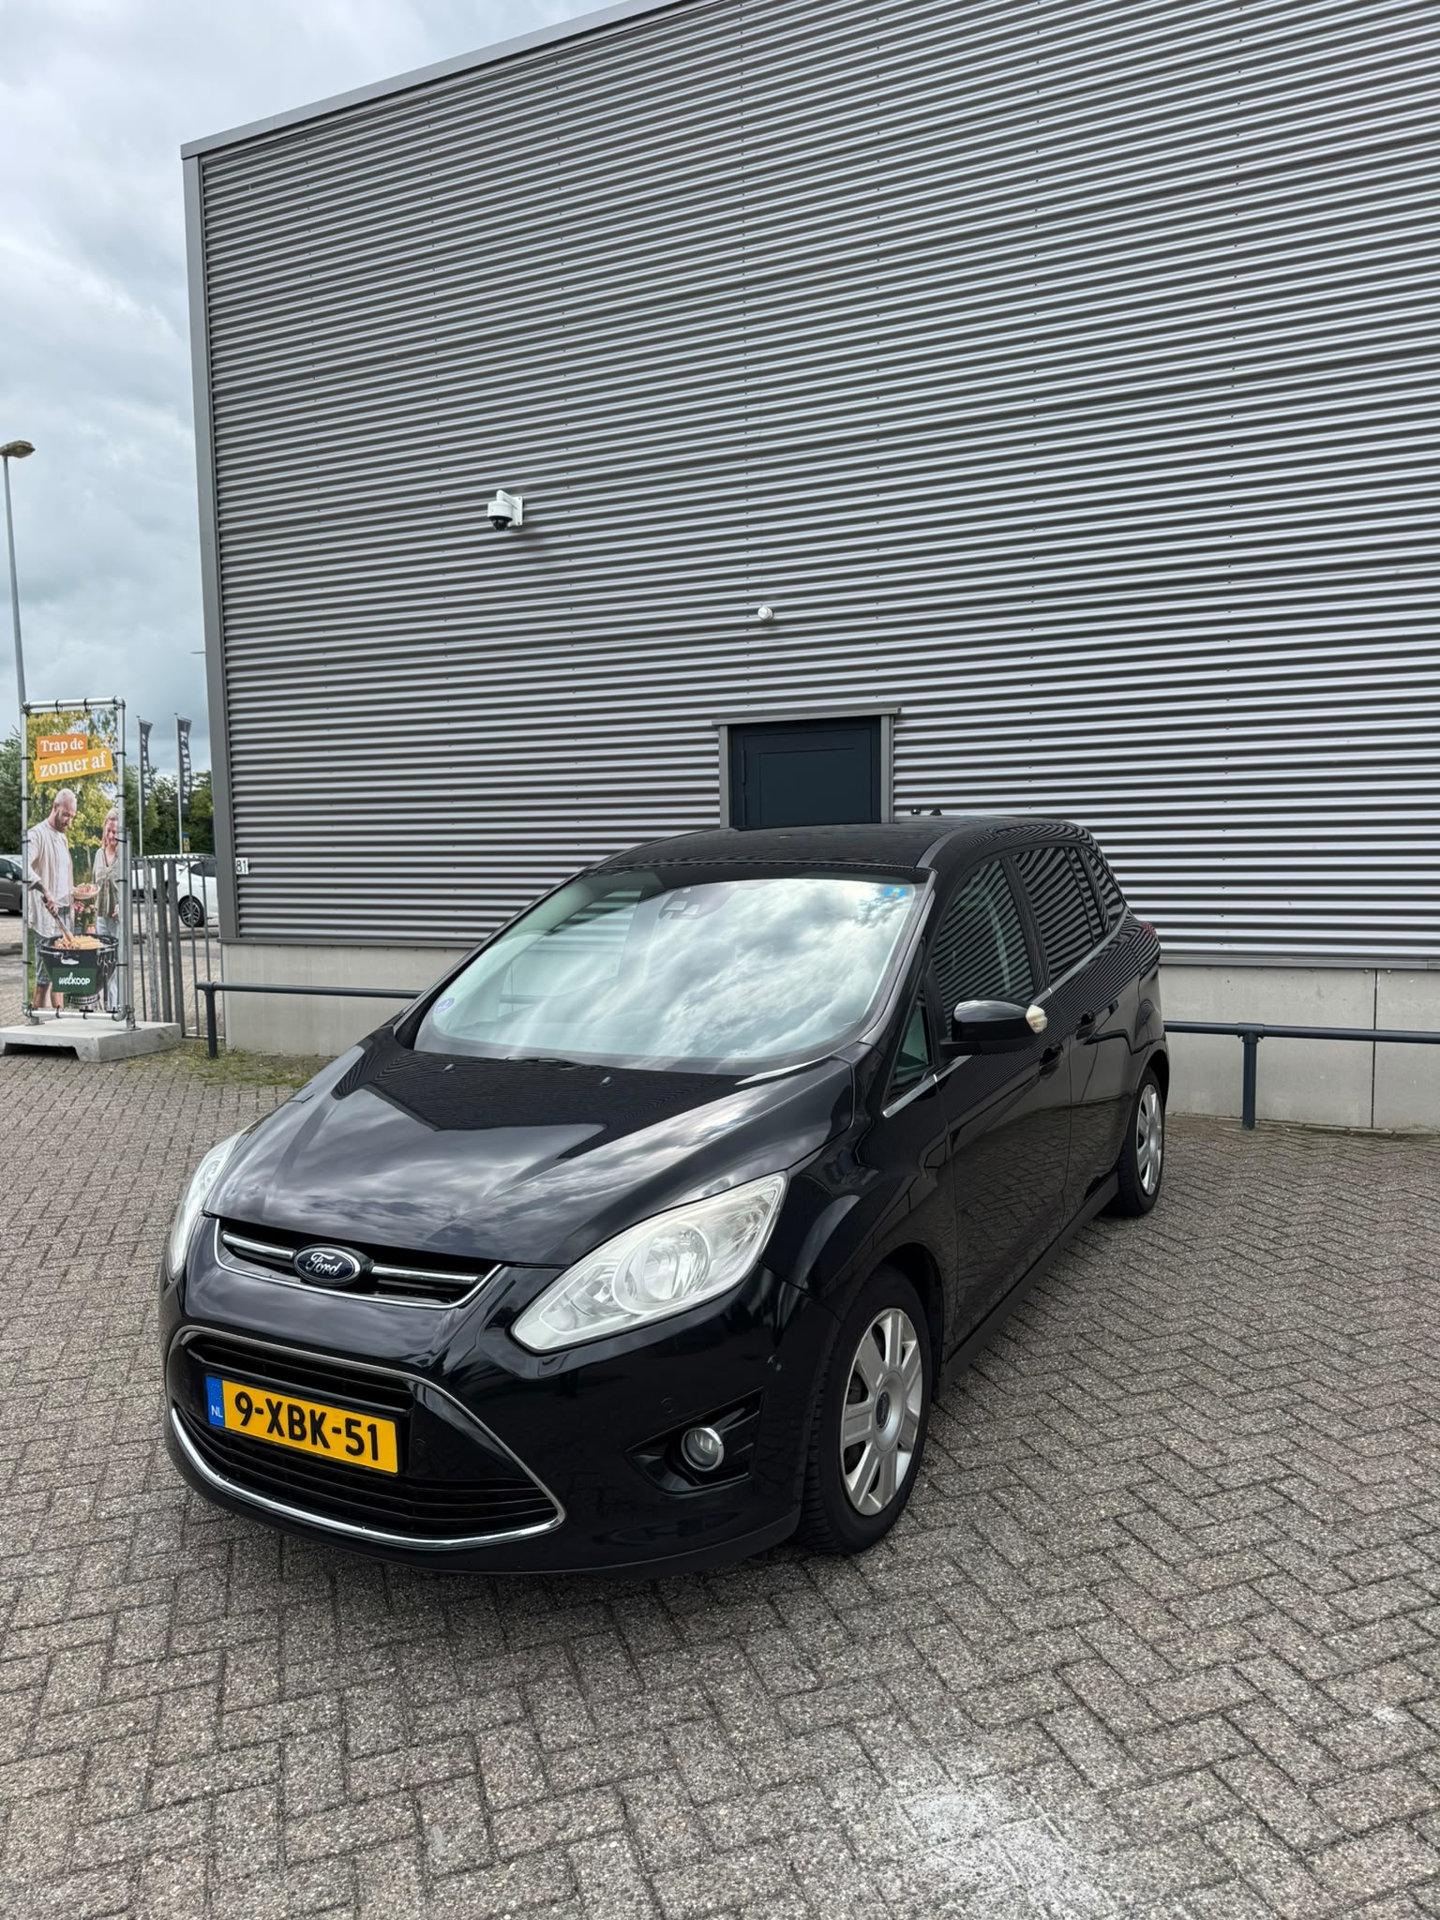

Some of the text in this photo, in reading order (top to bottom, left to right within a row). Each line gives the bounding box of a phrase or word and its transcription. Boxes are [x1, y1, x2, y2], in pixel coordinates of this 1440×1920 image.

[40, 738, 84, 754] Trap de
[40, 750, 107, 777] zomer af
[305, 1252, 343, 1276] Ford
[211, 1405, 223, 1418] NL
[234, 1391, 379, 1461] 9-XBK-51
